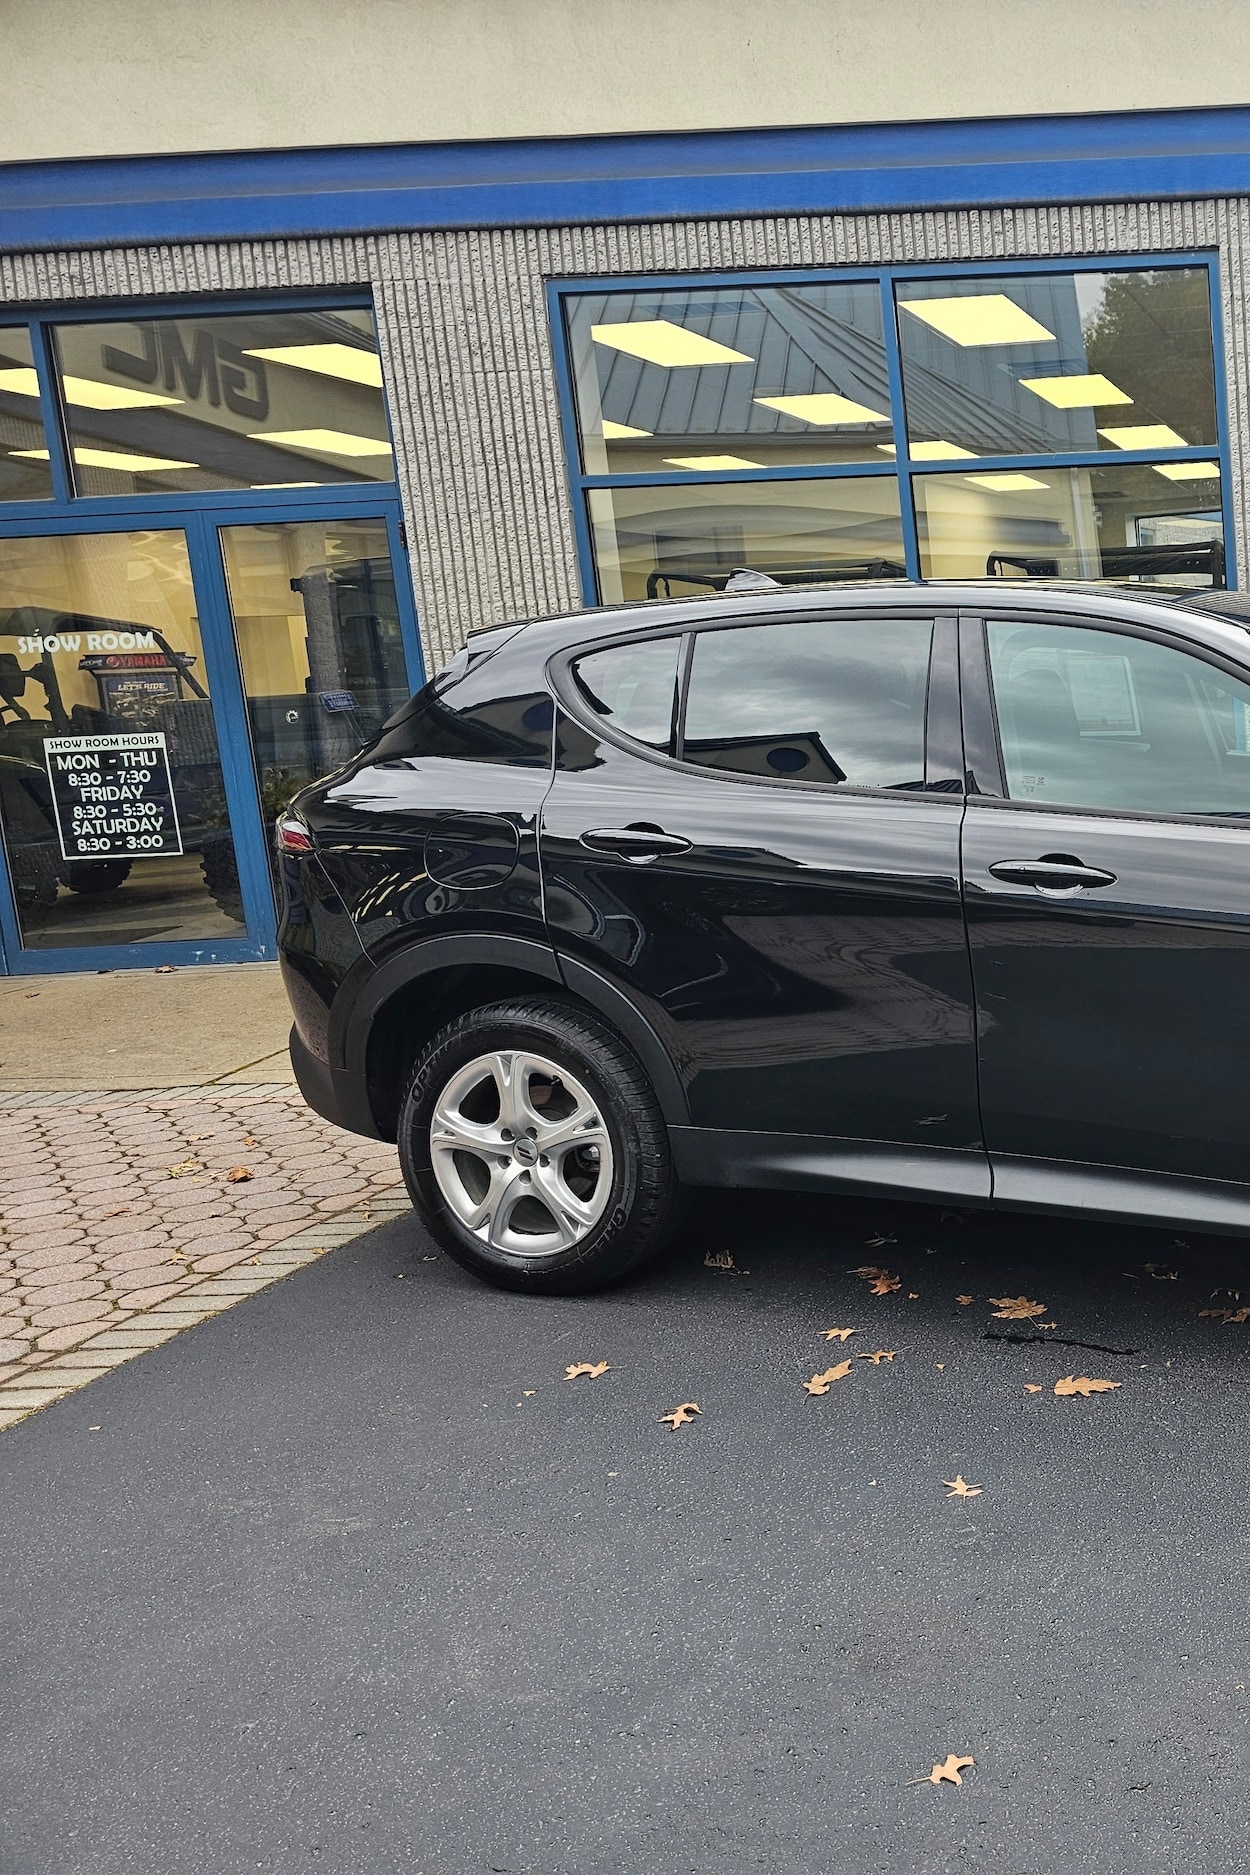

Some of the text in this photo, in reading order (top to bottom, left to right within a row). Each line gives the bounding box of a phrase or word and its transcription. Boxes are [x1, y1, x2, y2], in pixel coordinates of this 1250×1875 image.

[17, 632, 156, 655] SHOW ROOM
[119, 655, 167, 668] YAMAHA
[49, 736, 160, 749] SHOW ROOM HOURS
[56, 753, 99, 771] MON
[120, 751, 157, 767] THU
[68, 772, 102, 786] 8:30
[119, 769, 151, 783] 7:30
[80, 785, 144, 802] FRIDAY
[73, 805, 107, 820] 8:30
[123, 803, 157, 817] 5:30
[72, 817, 163, 836] SATURDAY
[77, 837, 111, 851] 8:30
[126, 835, 164, 849] 3:00
